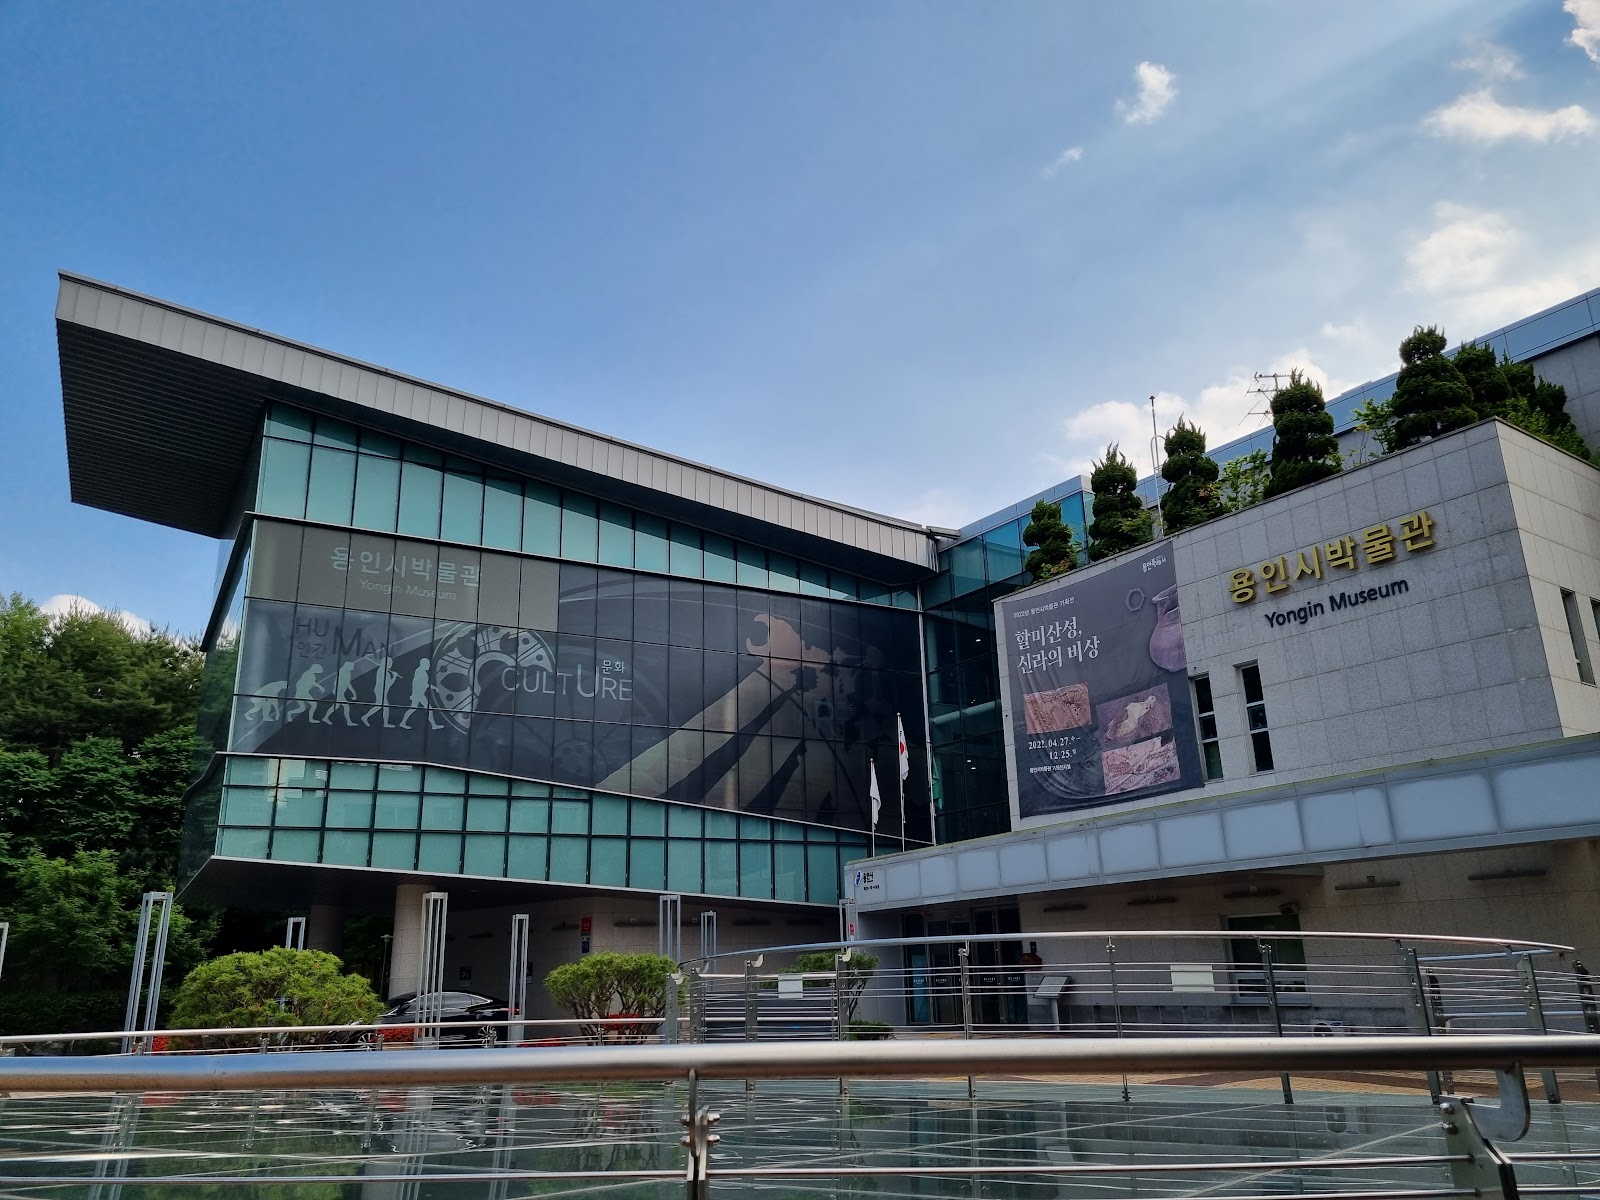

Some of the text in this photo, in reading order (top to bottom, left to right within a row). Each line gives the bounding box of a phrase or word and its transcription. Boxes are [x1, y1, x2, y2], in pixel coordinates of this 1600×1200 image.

[330, 546, 483, 588] 용인시박물관
[1229, 510, 1436, 603] 용인시박물관
[360, 579, 457, 601] Yongin Museum
[1264, 579, 1410, 628] Yongin Museum
[297, 642, 327, 660] 인간
[1015, 616, 1082, 650] 할미산성,
[601, 659, 626, 675] 문화
[1018, 635, 1101, 674] 신라의 비상
[501, 664, 633, 701] CULTURE
